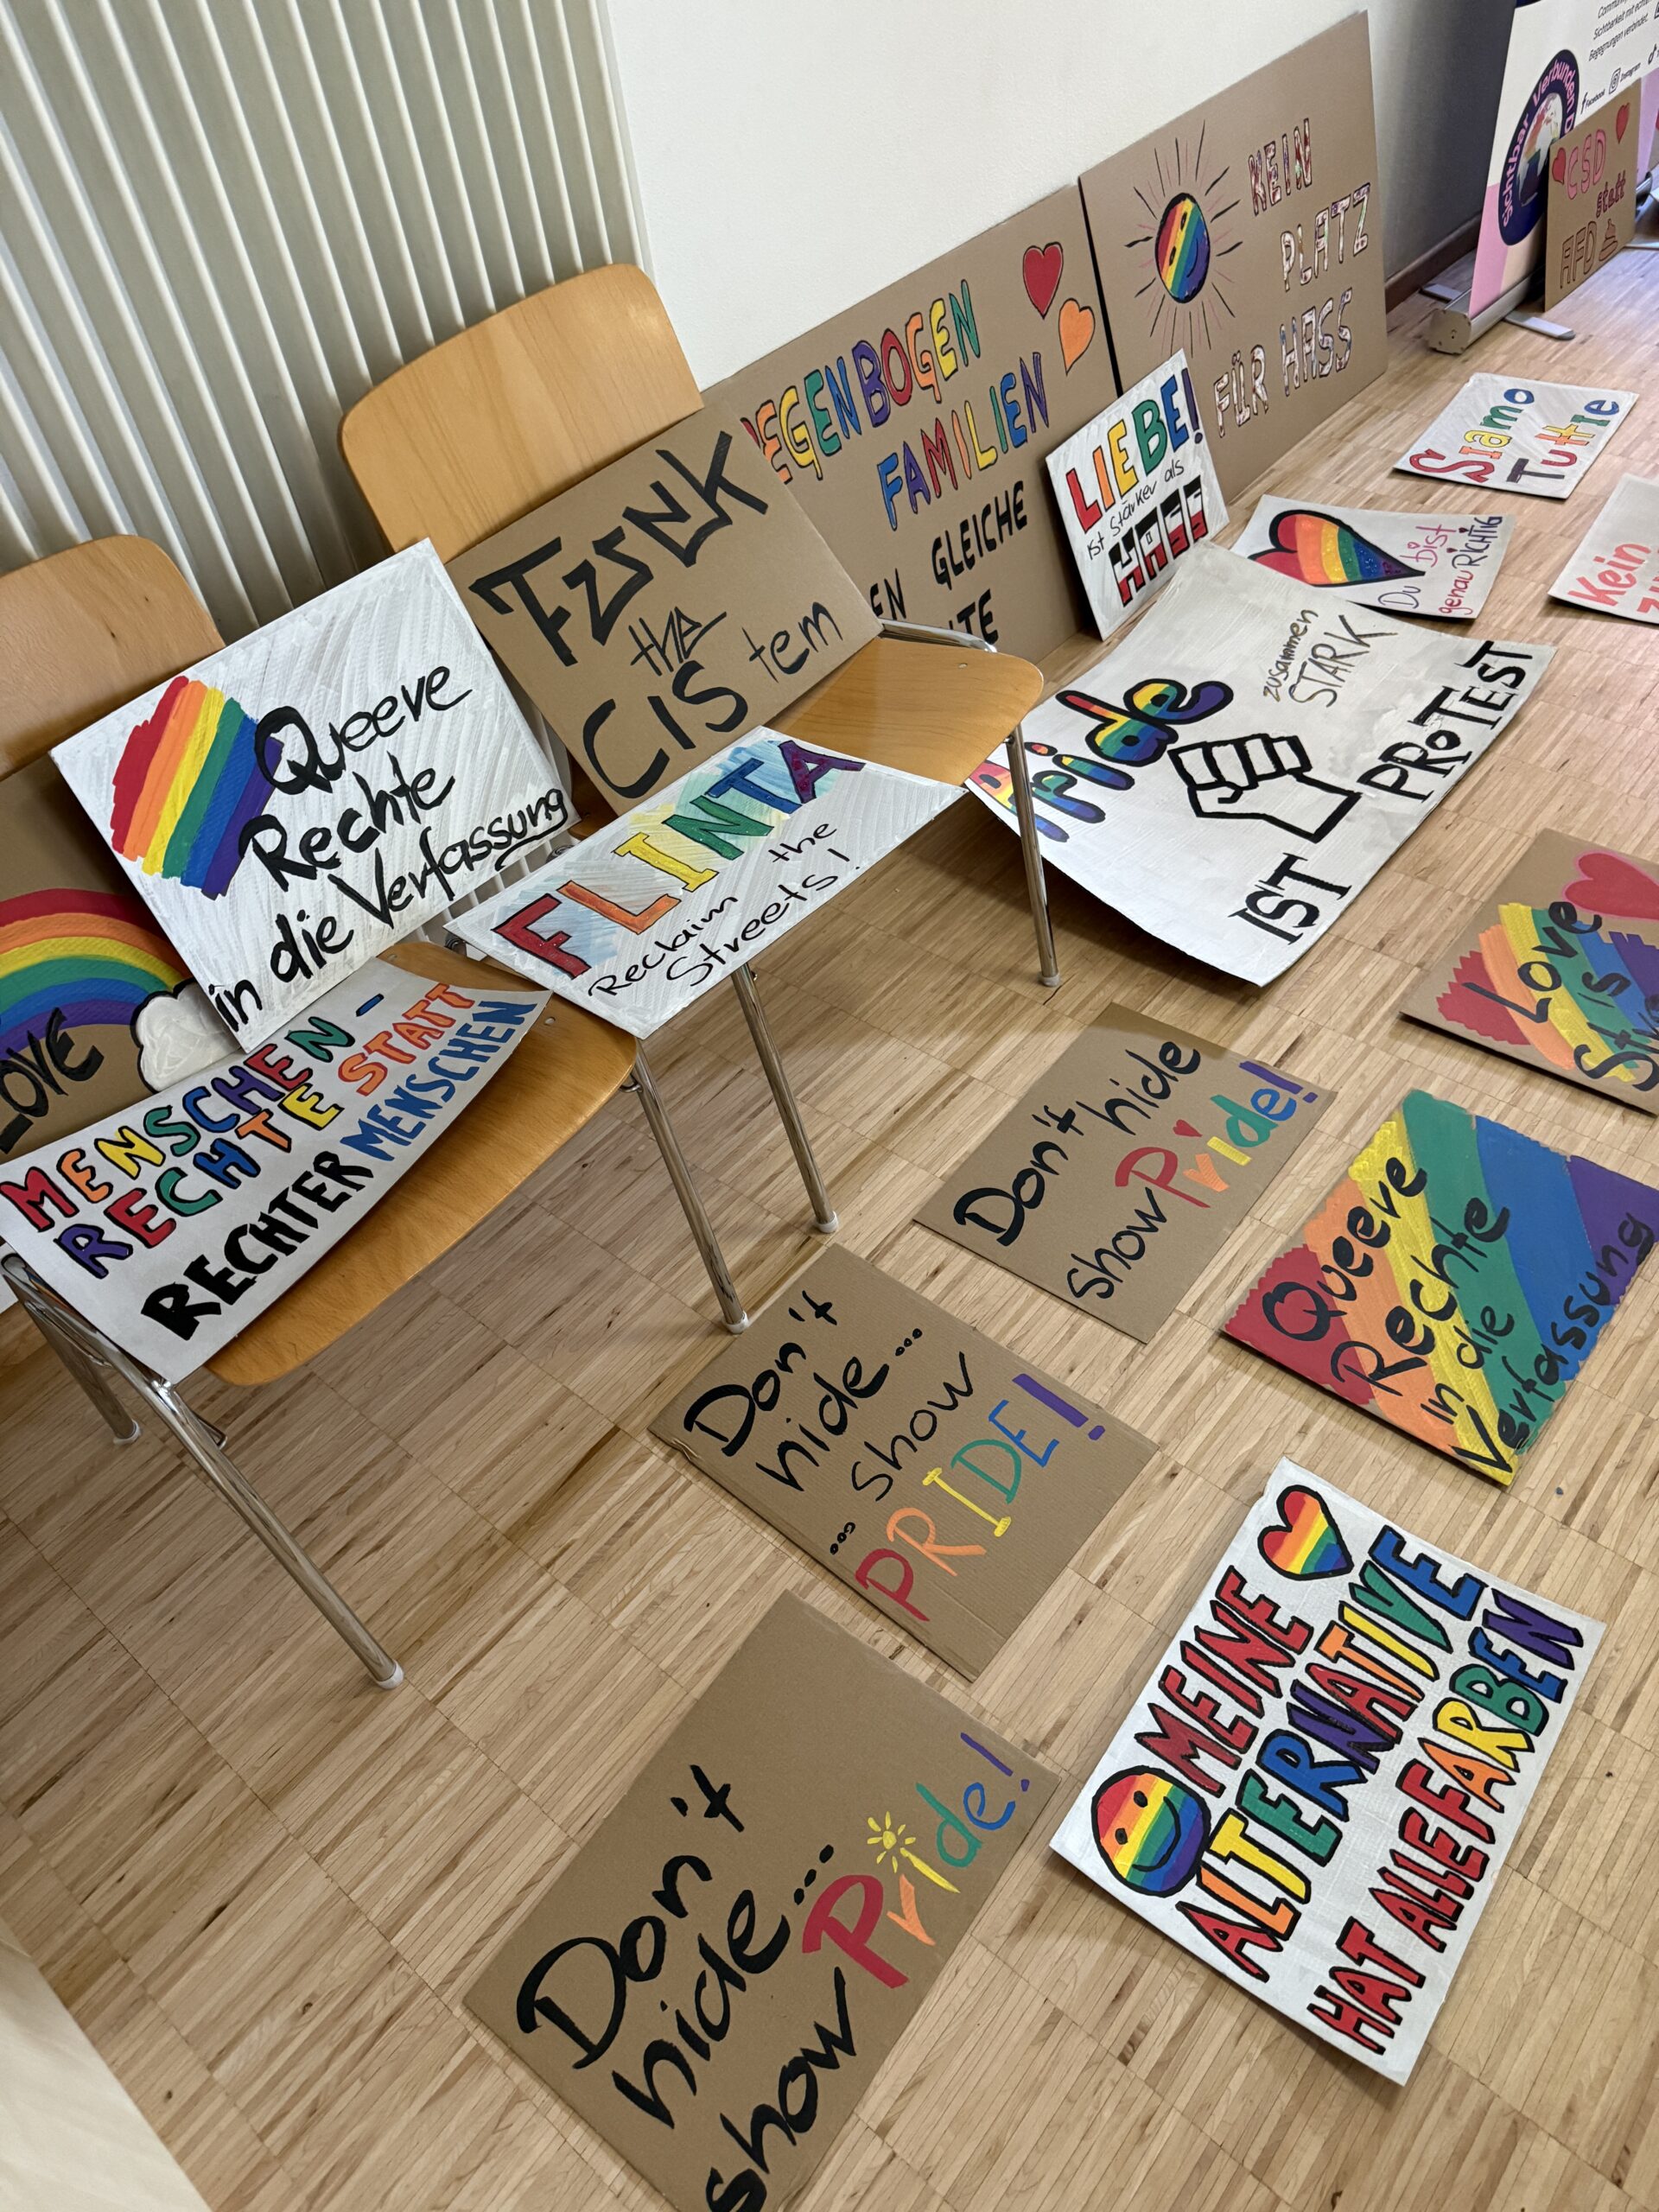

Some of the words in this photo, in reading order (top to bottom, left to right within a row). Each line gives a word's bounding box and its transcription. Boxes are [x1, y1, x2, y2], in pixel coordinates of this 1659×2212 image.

[1502, 113, 1529, 227] Sichtbar
[1533, 59, 1575, 113] Verbunden
[1586, 89, 1605, 109] Facebook
[1620, 62, 1641, 82] Instagram
[1248, 118, 1313, 216] KEIN
[1280, 182, 1370, 291] PLATZ
[1567, 128, 1606, 200] CSD
[1596, 169, 1626, 219] statt
[1213, 344, 1268, 438] FÜR
[1280, 287, 1352, 397] HASS
[876, 352, 1049, 531] FAMILIEN
[1065, 367, 1204, 534] LIEBE!
[1165, 459, 1185, 482] als
[931, 480, 1027, 590] GLEICHE
[1109, 474, 1208, 607] HASS
[1377, 585, 1421, 609] Du
[1400, 524, 1457, 568] bist
[1439, 569, 1474, 615] genau
[1567, 543, 1651, 607] Kein
[1288, 614, 1398, 708] STARK
[238, 751, 456, 892] Rechte
[491, 739, 866, 980] FLINTA
[208, 976, 262, 1033] in
[269, 910, 354, 982] die
[328, 787, 569, 928] Verfassung
[588, 897, 739, 997] Reclaim
[768, 819, 836, 863] the
[1228, 851, 1352, 945] IST
[54, 1083, 345, 1279] RECHTE
[338, 982, 474, 1097] STATT
[140, 1150, 374, 1340] RECHTER
[340, 999, 537, 1161] MENSCHEN
[953, 1104, 1085, 1247] Don't
[1076, 1040, 1201, 1136] hide
[1115, 1059, 1319, 1209] Pride!
[1331, 1197, 1510, 1397] Rechte
[1421, 1382, 1465, 1425] in
[1456, 1306, 1515, 1370] die
[1448, 1211, 1655, 1473] Verfassung
[683, 1290, 838, 1457] Don't
[855, 1372, 1106, 1622] PRIDE!
[1135, 1566, 1314, 1798] MEINE
[1177, 1525, 1488, 1982] ALTERNATIVE
[516, 1764, 745, 2070] Don't
[801, 1732, 1031, 1989] Pride!
[1306, 1917, 1426, 2055] HAT
